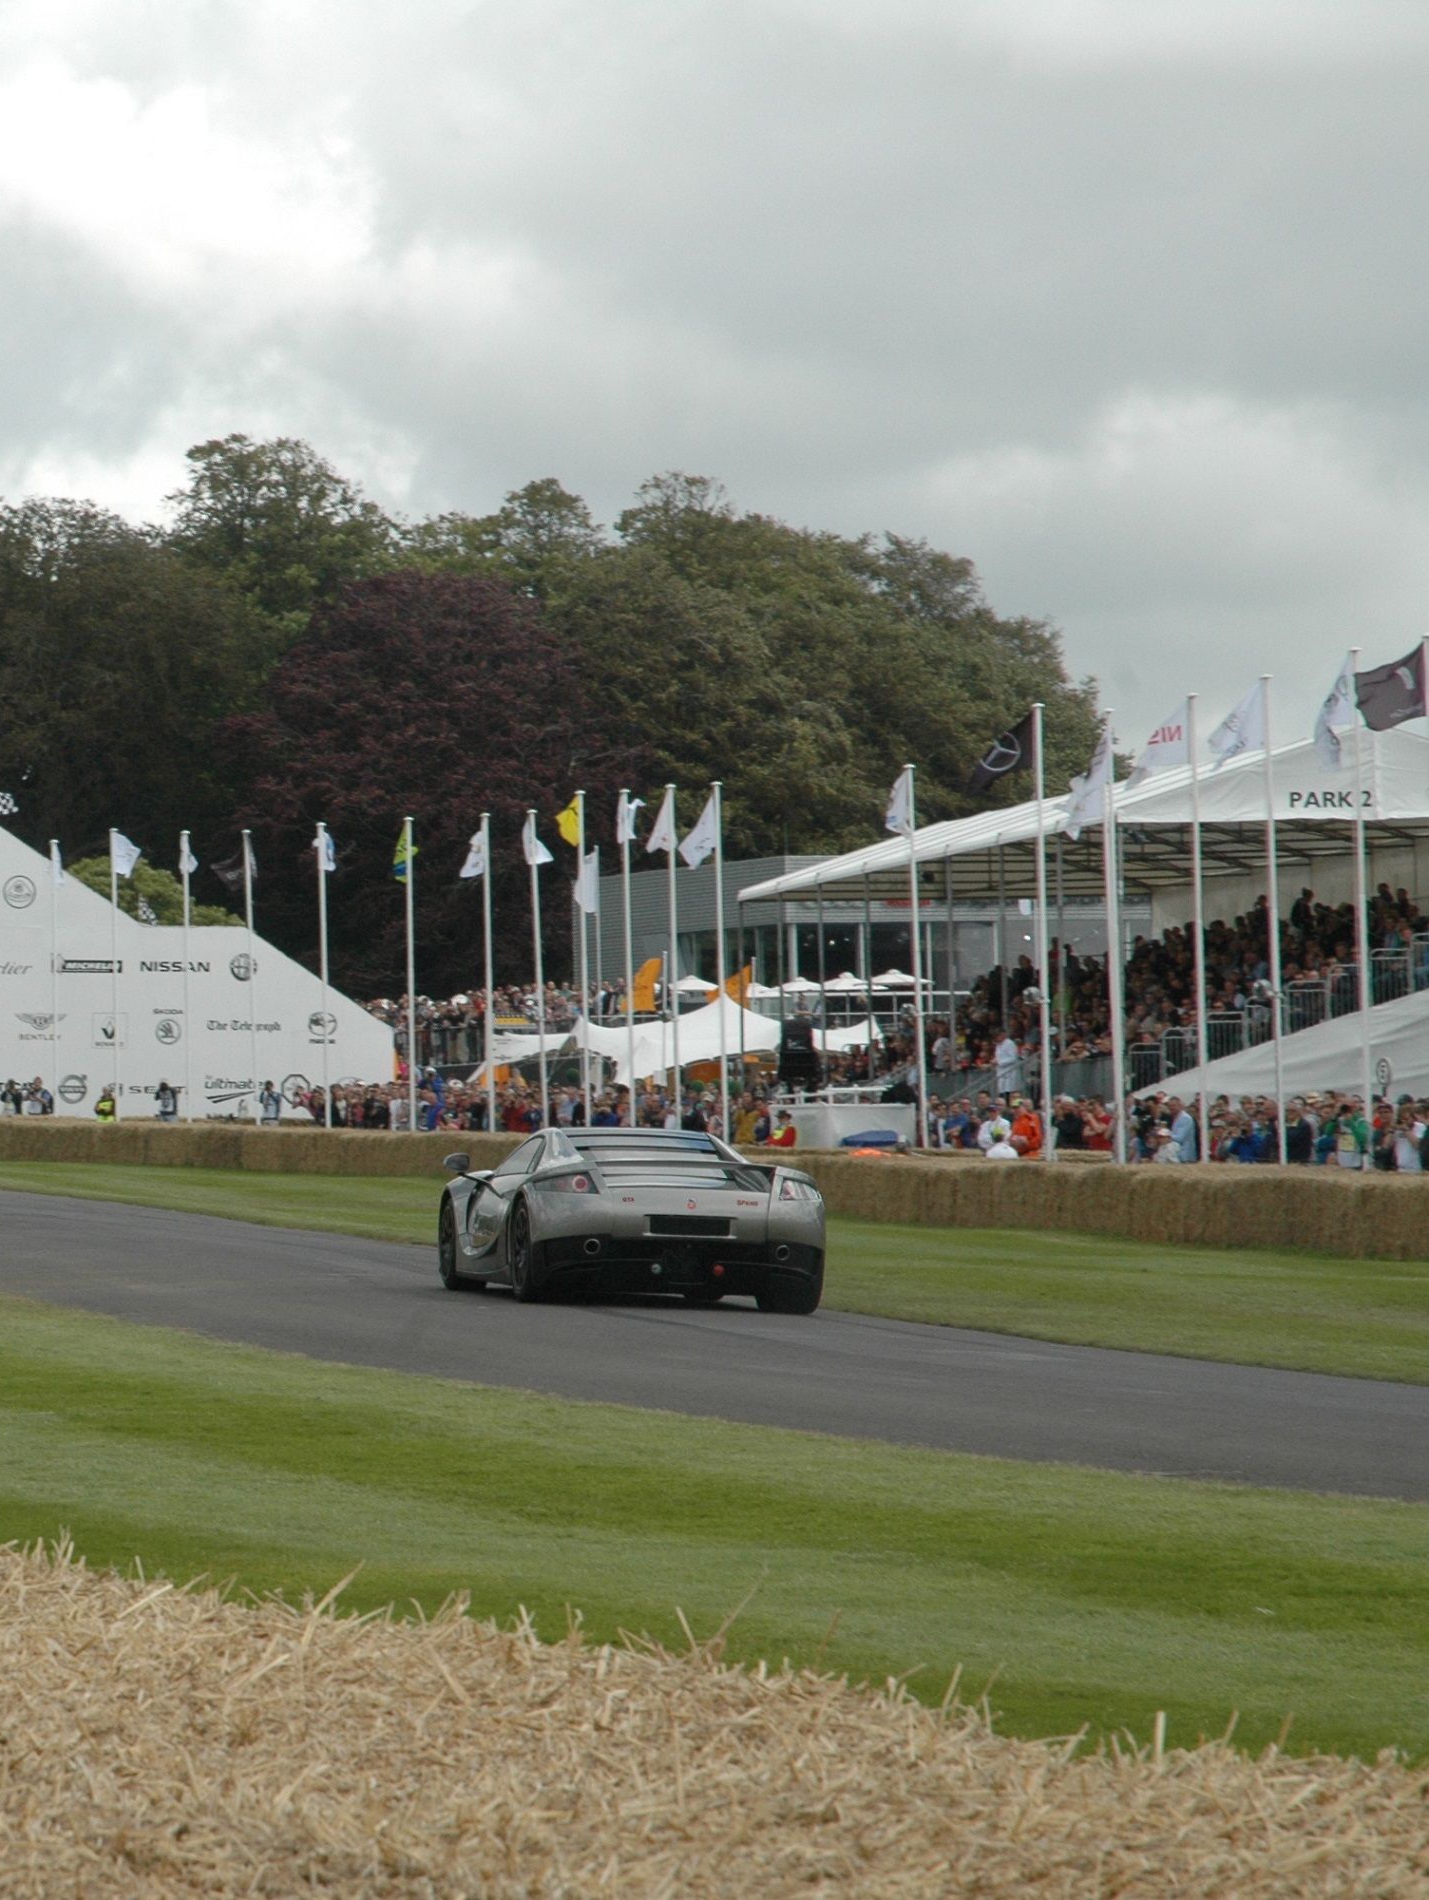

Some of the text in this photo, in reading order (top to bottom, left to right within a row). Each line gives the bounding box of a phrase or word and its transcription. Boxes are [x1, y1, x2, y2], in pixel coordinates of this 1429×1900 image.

[1289, 790, 1374, 808] PARK 2
[140, 961, 211, 972] NISSAN
[230, 1020, 281, 1032] Teleraph
[129, 1086, 186, 1094] SET
